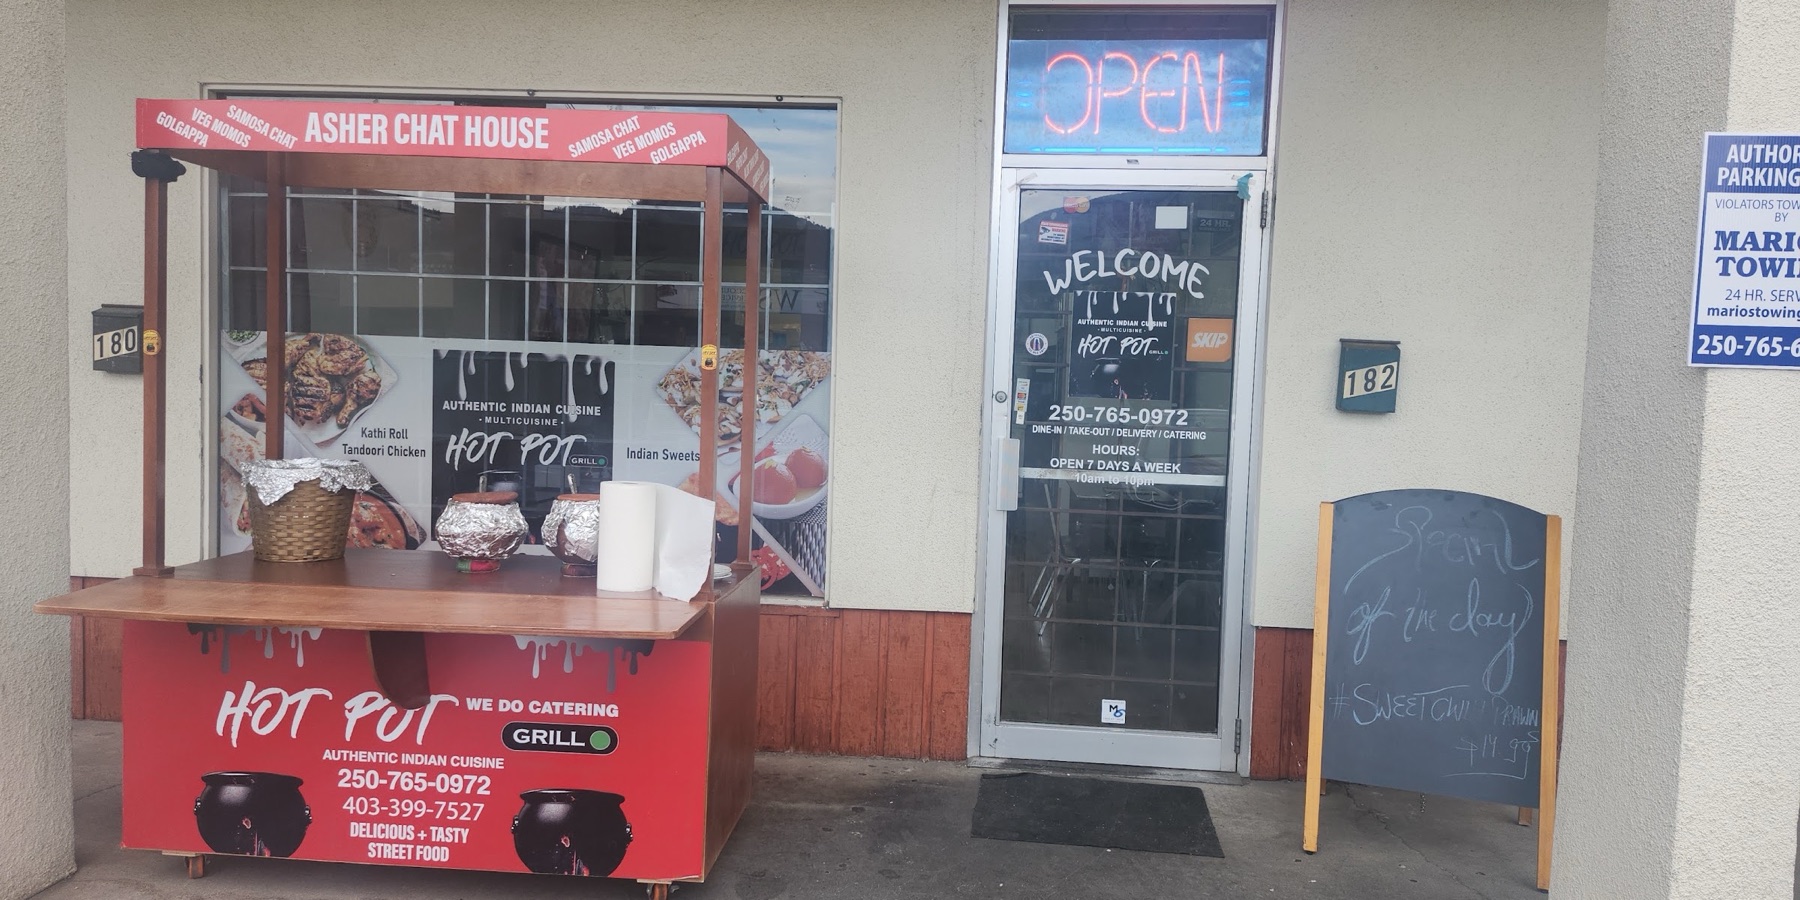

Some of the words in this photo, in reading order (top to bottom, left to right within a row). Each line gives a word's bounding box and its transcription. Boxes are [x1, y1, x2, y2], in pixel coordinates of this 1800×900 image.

[1042, 51, 1224, 135] OPEN
[156, 111, 209, 148] GOLGAPPA
[191, 107, 213, 128] VEG
[210, 118, 251, 148] MOMOS
[226, 104, 270, 137] SAMOSA
[268, 126, 298, 149] CHAT
[304, 112, 388, 144] ASHER
[394, 113, 459, 146] CHAT
[464, 115, 549, 149] HOUSE
[568, 128, 615, 158] SAMOSA
[612, 115, 641, 138] CHAT
[612, 140, 636, 160] VEG
[633, 121, 677, 151] MOMOS
[649, 130, 707, 164] GOLGAPPA
[1717, 167, 1800, 187] PARKING
[1715, 199, 1774, 209] VIOLATORS
[1774, 212, 1789, 222] BY
[1713, 230, 1800, 252] MARI
[1043, 248, 1210, 299] WELCOME
[1715, 257, 1800, 278] TOWI
[1725, 289, 1740, 301] 24
[1744, 289, 1766, 302] HR.
[1077, 318, 1114, 326] AUTHENTIC
[1141, 320, 1168, 328] CUSINE
[96, 328, 136, 358] 180
[1078, 333, 1117, 359] HOT
[1120, 336, 1159, 357] POT
[1191, 332, 1229, 349] SKIP
[1347, 364, 1395, 396] 182
[442, 401, 507, 412] AUTHENTIC
[511, 403, 550, 414] INDIAN
[1048, 404, 1188, 426] 250-765-0972
[485, 416, 558, 426] MULTICUISINE
[361, 427, 386, 439] Kathi
[389, 428, 408, 440] Roll
[1032, 425, 1063, 434] DINE-IN
[1069, 426, 1110, 436] TAKE-OUT
[1116, 428, 1157, 438] DELIVERY
[1163, 430, 1206, 440] CATERING
[342, 443, 384, 456] Tandoori
[387, 445, 426, 458] Chicken
[445, 428, 514, 471] HOT
[520, 433, 587, 467] POT
[626, 447, 659, 460] Indian
[662, 448, 700, 462] Sweets
[1092, 444, 1140, 456] HOURS:
[571, 457, 597, 465] GRILL
[1050, 457, 1084, 470] OPEN
[1087, 459, 1094, 470] 7
[1097, 460, 1130, 472] DAYS
[1132, 462, 1141, 472] A
[1144, 462, 1181, 474] WEEK
[1075, 472, 1105, 484] 10am
[1108, 474, 1120, 485] to
[1124, 475, 1155, 487] 10pm
[1347, 586, 1396, 666] of
[216, 680, 333, 748] HOT
[344, 691, 460, 746] POT
[466, 697, 493, 712] WE
[498, 699, 524, 714] DO
[528, 701, 620, 718] CATERING
[512, 728, 586, 748] GRILL
[322, 750, 399, 765] AUTHENTIC
[401, 754, 447, 767] INDIAN
[450, 756, 505, 770] CUISINE
[337, 768, 492, 796] 250-765-0972
[342, 796, 485, 822] 403-399-7527
[350, 822, 415, 841] DELICIOUS
[430, 826, 470, 844] TASTY
[367, 842, 414, 860] STREET
[416, 844, 450, 862] FOOD
